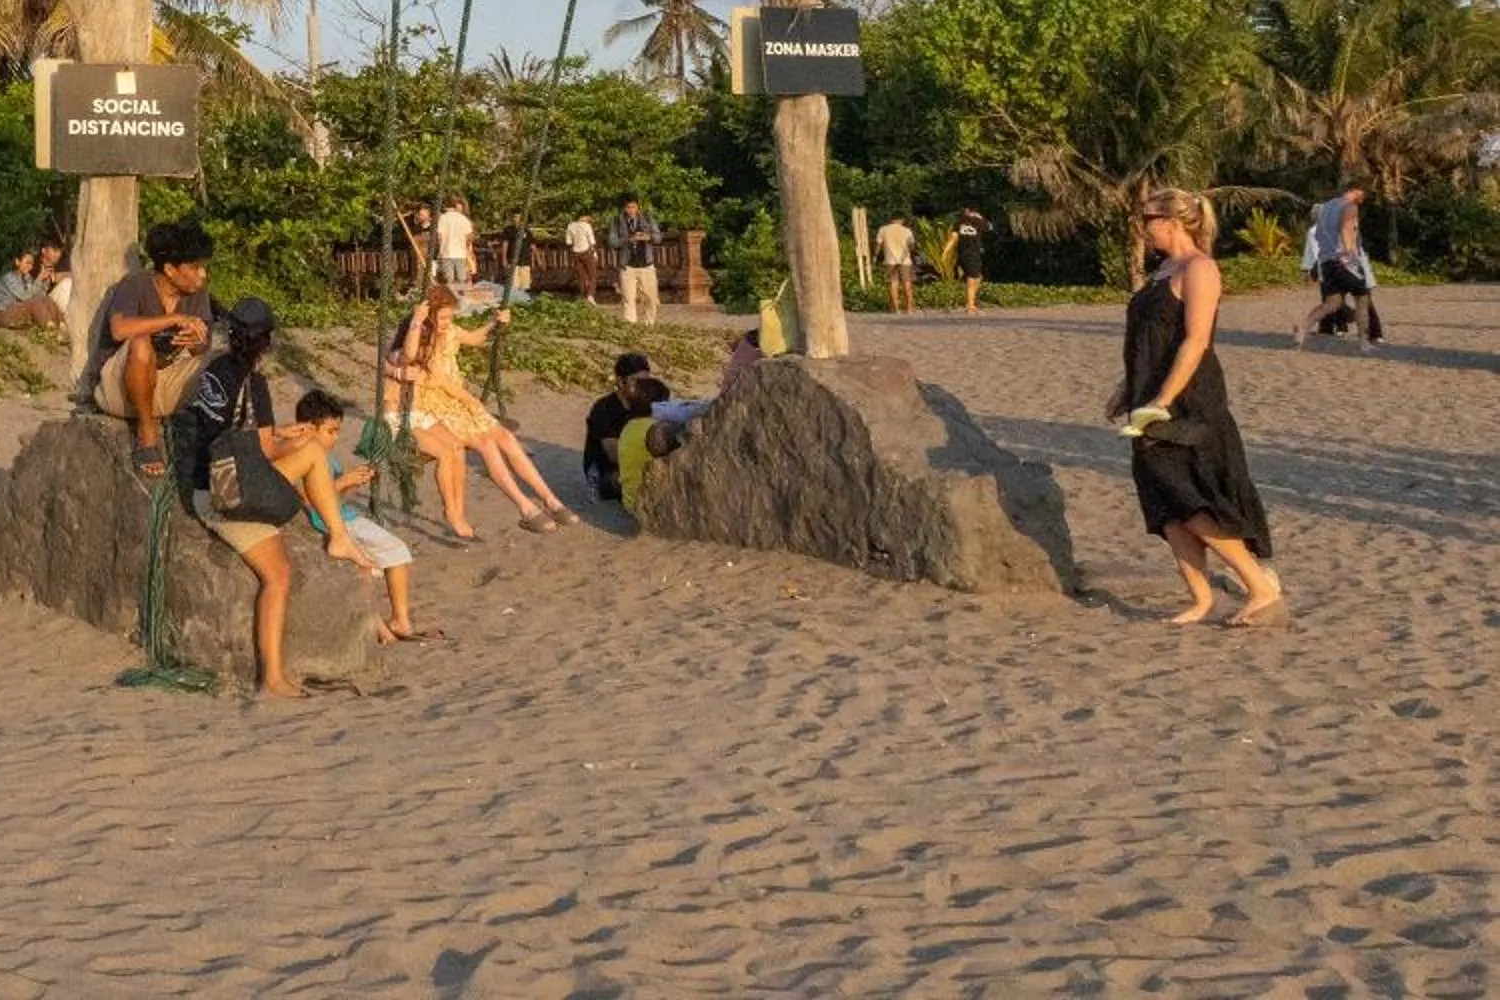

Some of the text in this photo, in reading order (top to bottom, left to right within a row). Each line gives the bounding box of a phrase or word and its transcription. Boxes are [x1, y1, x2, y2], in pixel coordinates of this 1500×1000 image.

[765, 41, 859, 57] ZONA MASKER
[93, 98, 161, 115] SOCIAL
[68, 119, 185, 137] DISTANCING
